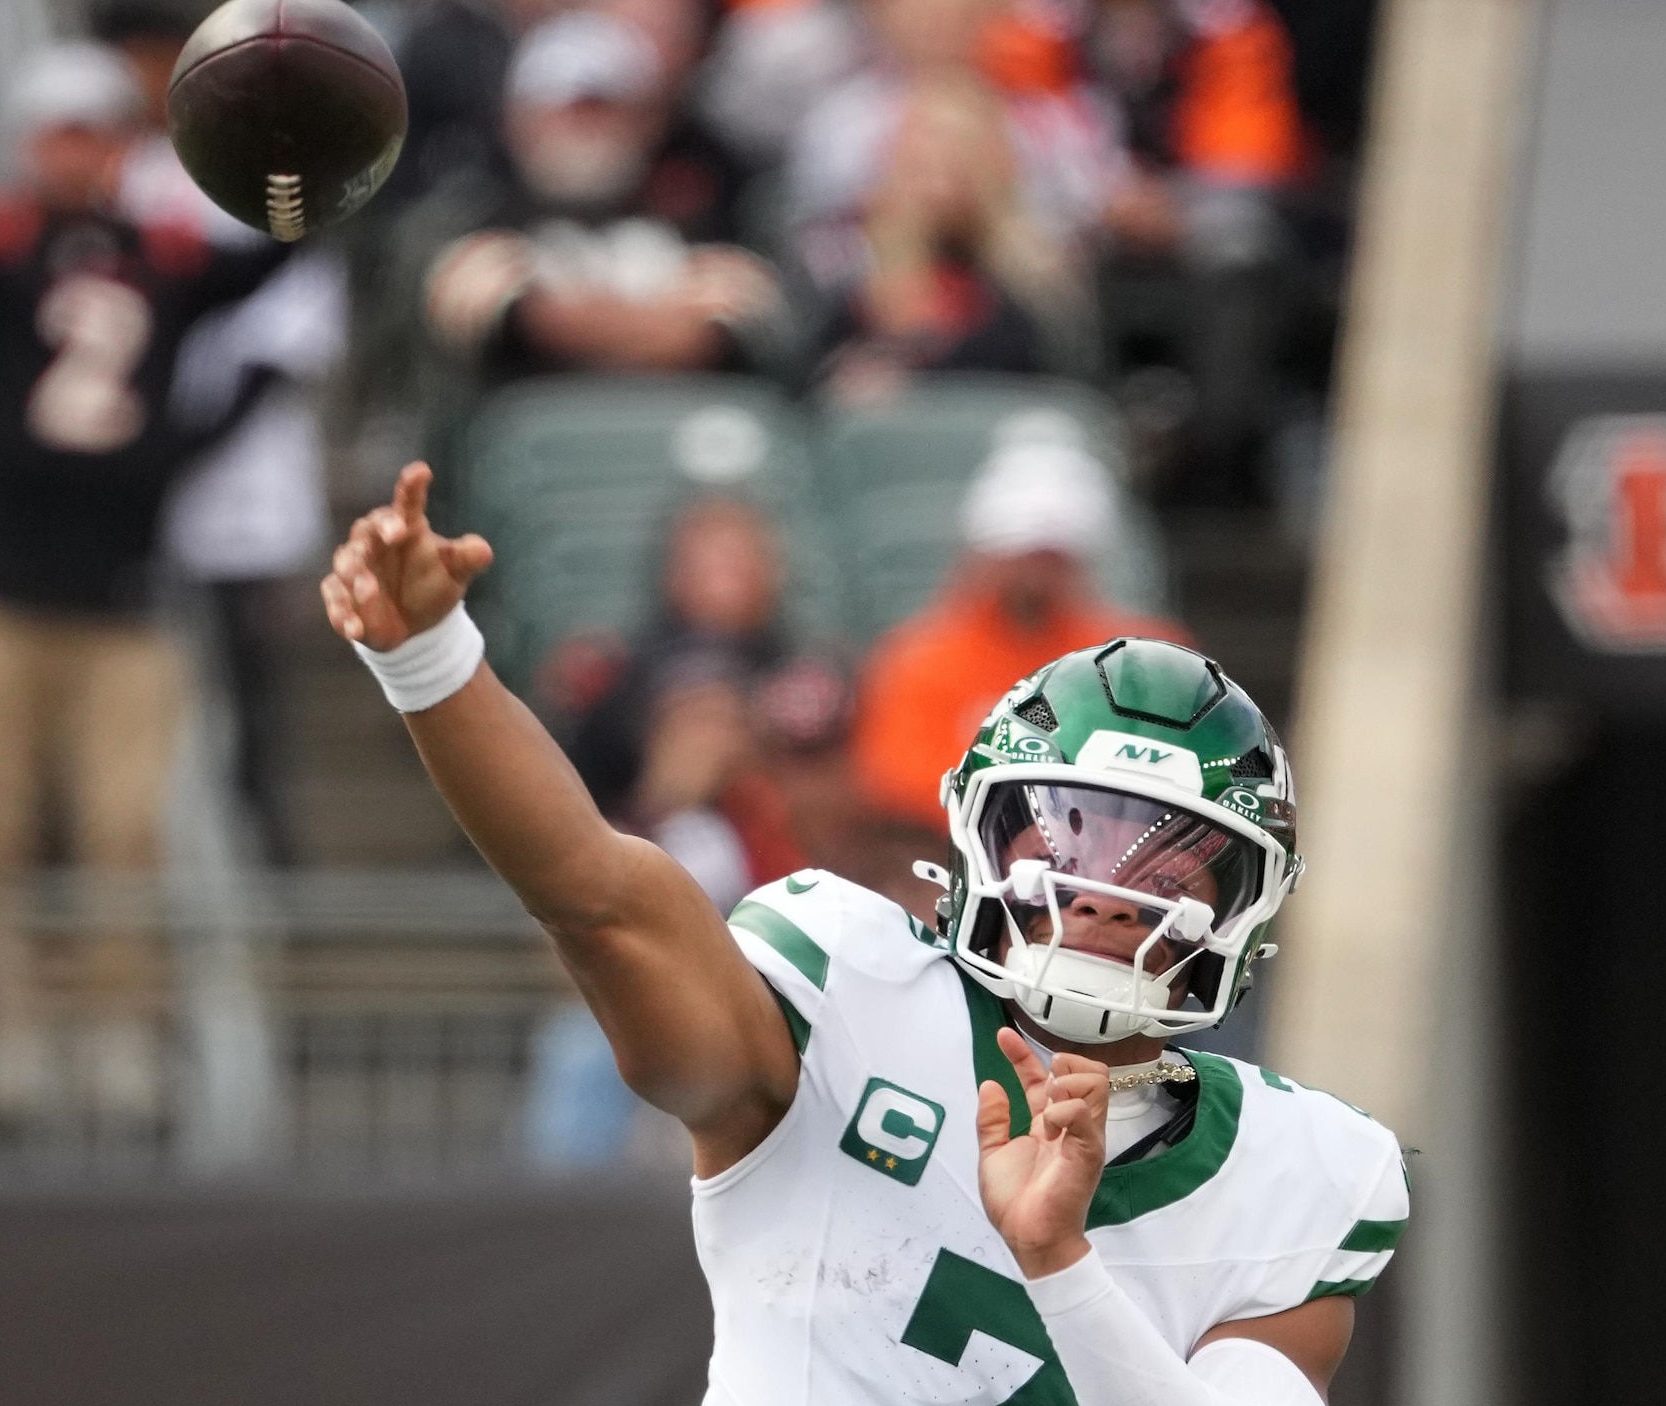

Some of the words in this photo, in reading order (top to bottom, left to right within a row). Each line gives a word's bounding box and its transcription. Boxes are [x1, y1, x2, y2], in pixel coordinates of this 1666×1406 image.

[1011, 752, 1057, 763] OAKLEY
[1115, 743, 1173, 764] NY
[1222, 799, 1262, 823] OAKLEY
[856, 1086, 938, 1161] C
